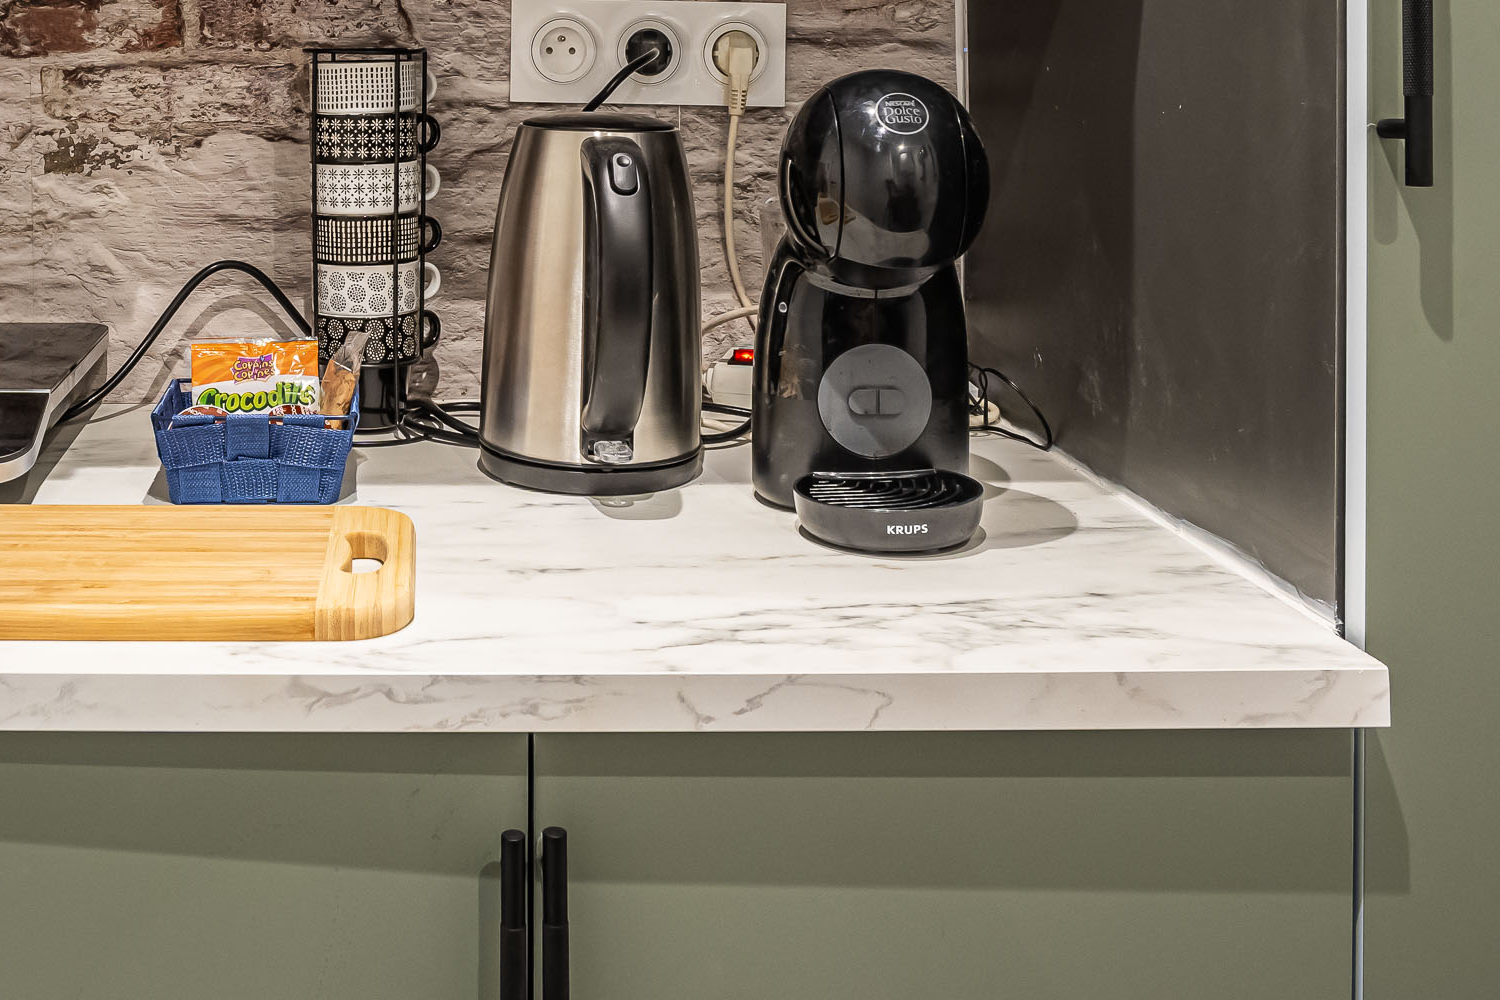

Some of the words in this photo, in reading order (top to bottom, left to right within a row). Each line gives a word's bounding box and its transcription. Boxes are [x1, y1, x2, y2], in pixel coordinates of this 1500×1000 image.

[884, 106, 920, 116] Dolce
[885, 114, 922, 124] Gusto
[886, 524, 929, 535] KRUPS
